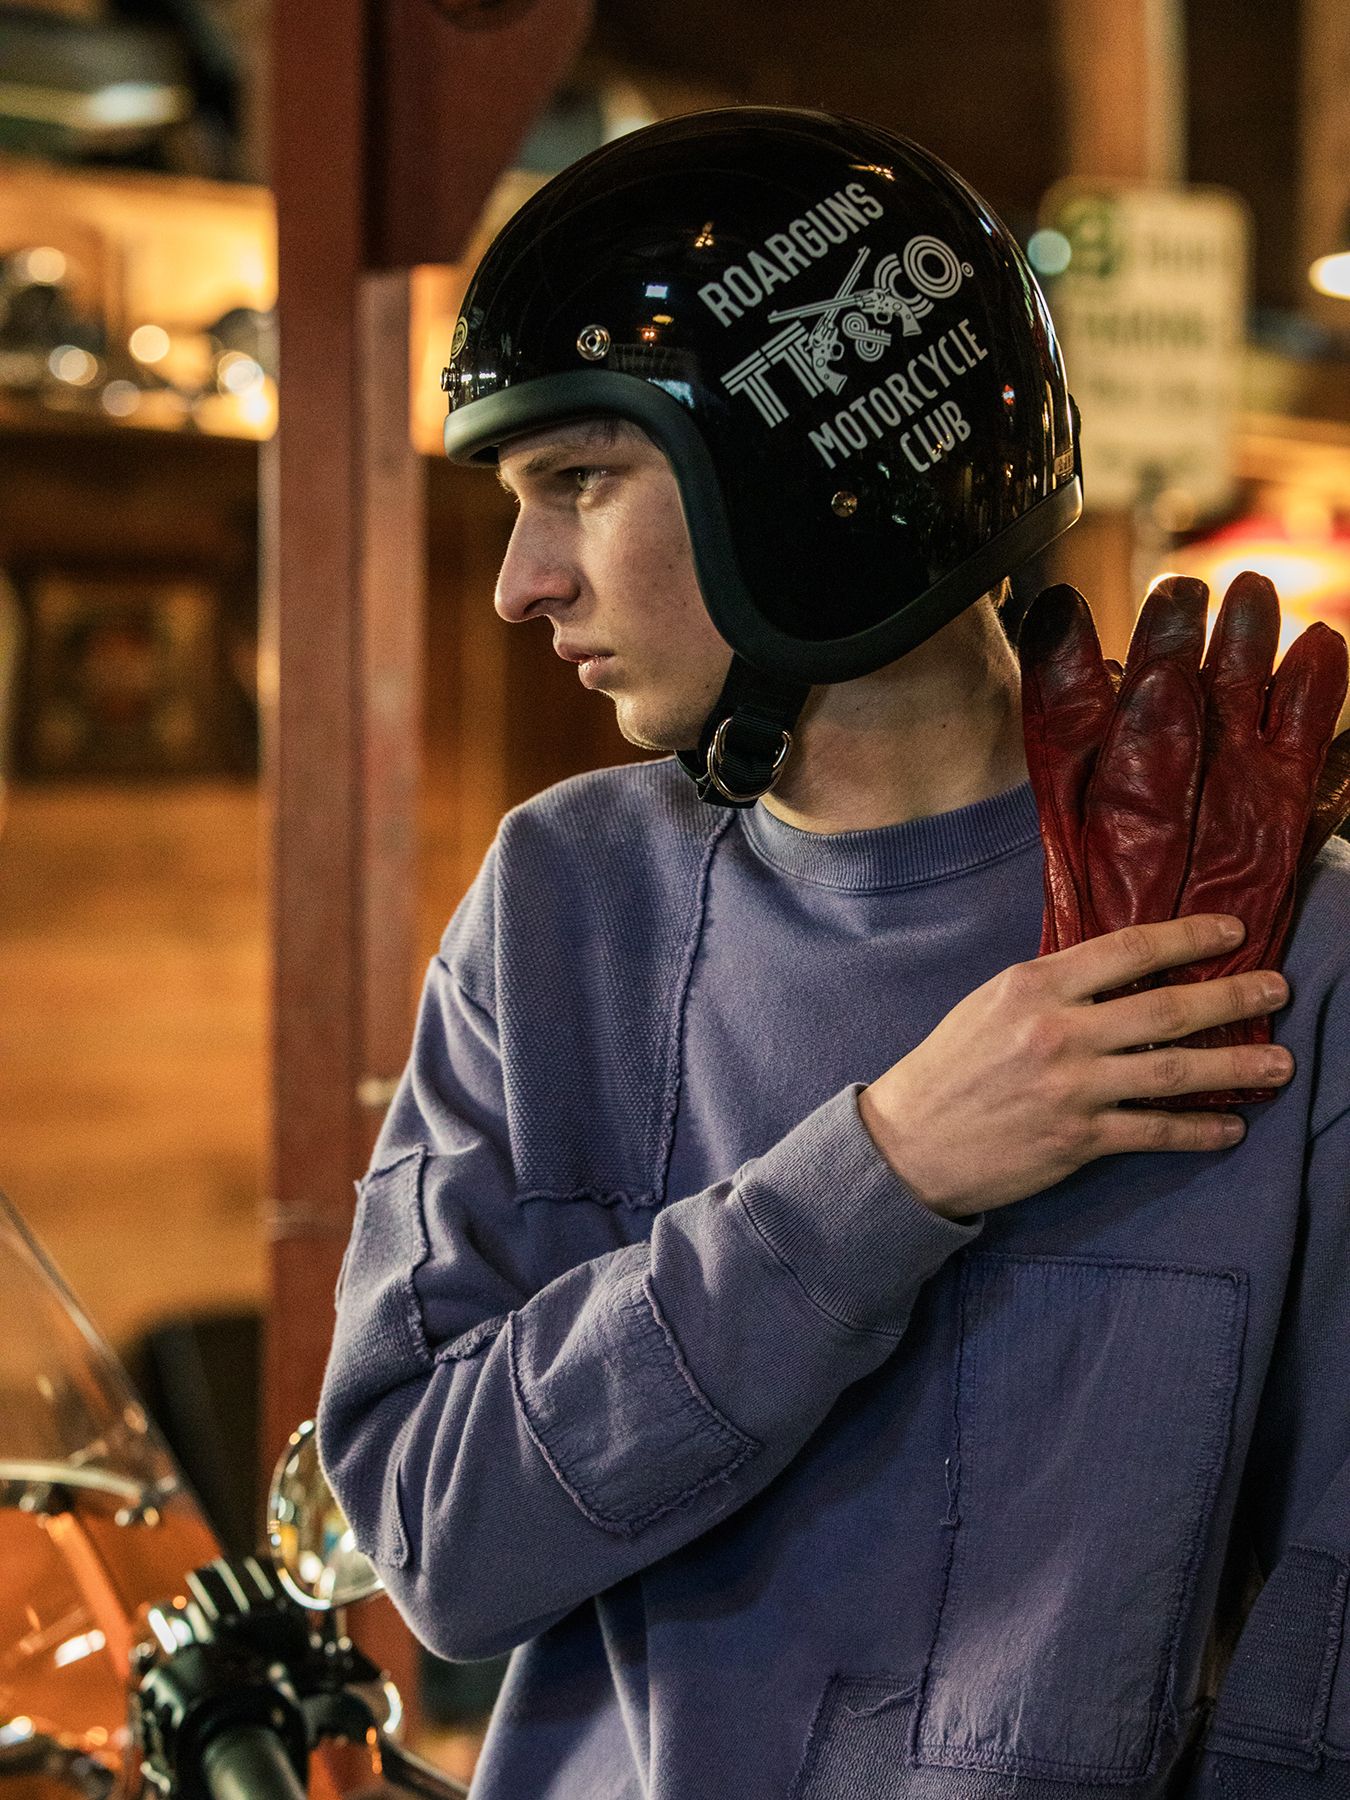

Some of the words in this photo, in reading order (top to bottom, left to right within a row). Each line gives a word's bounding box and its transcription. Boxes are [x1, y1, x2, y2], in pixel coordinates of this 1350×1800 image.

[697, 182, 883, 327] ROARGUNS
[808, 318, 988, 469] MOTORCYCLE
[900, 401, 972, 473] CLUB
